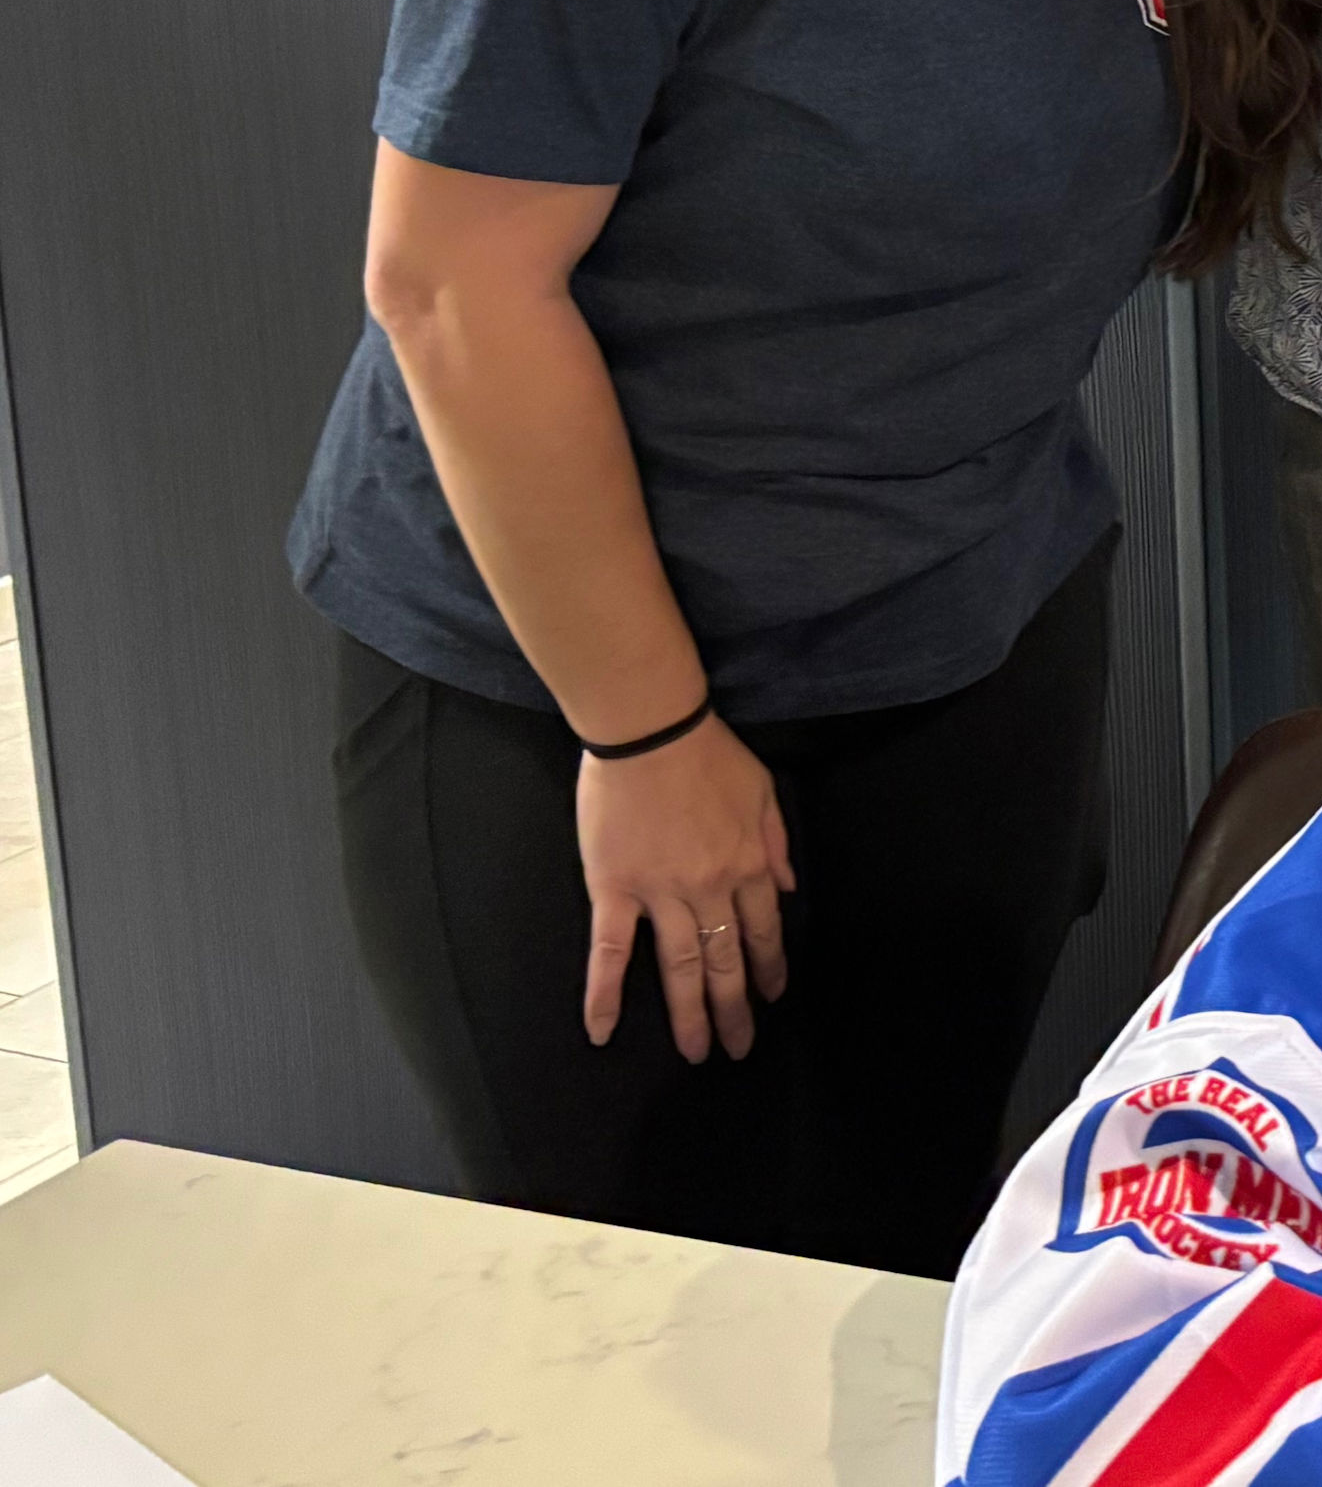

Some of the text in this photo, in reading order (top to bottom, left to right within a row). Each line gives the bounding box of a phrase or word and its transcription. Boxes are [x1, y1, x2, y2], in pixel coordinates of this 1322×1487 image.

[1124, 1074, 1281, 1153] THE REAL
[1096, 1150, 1225, 1230] IRON
